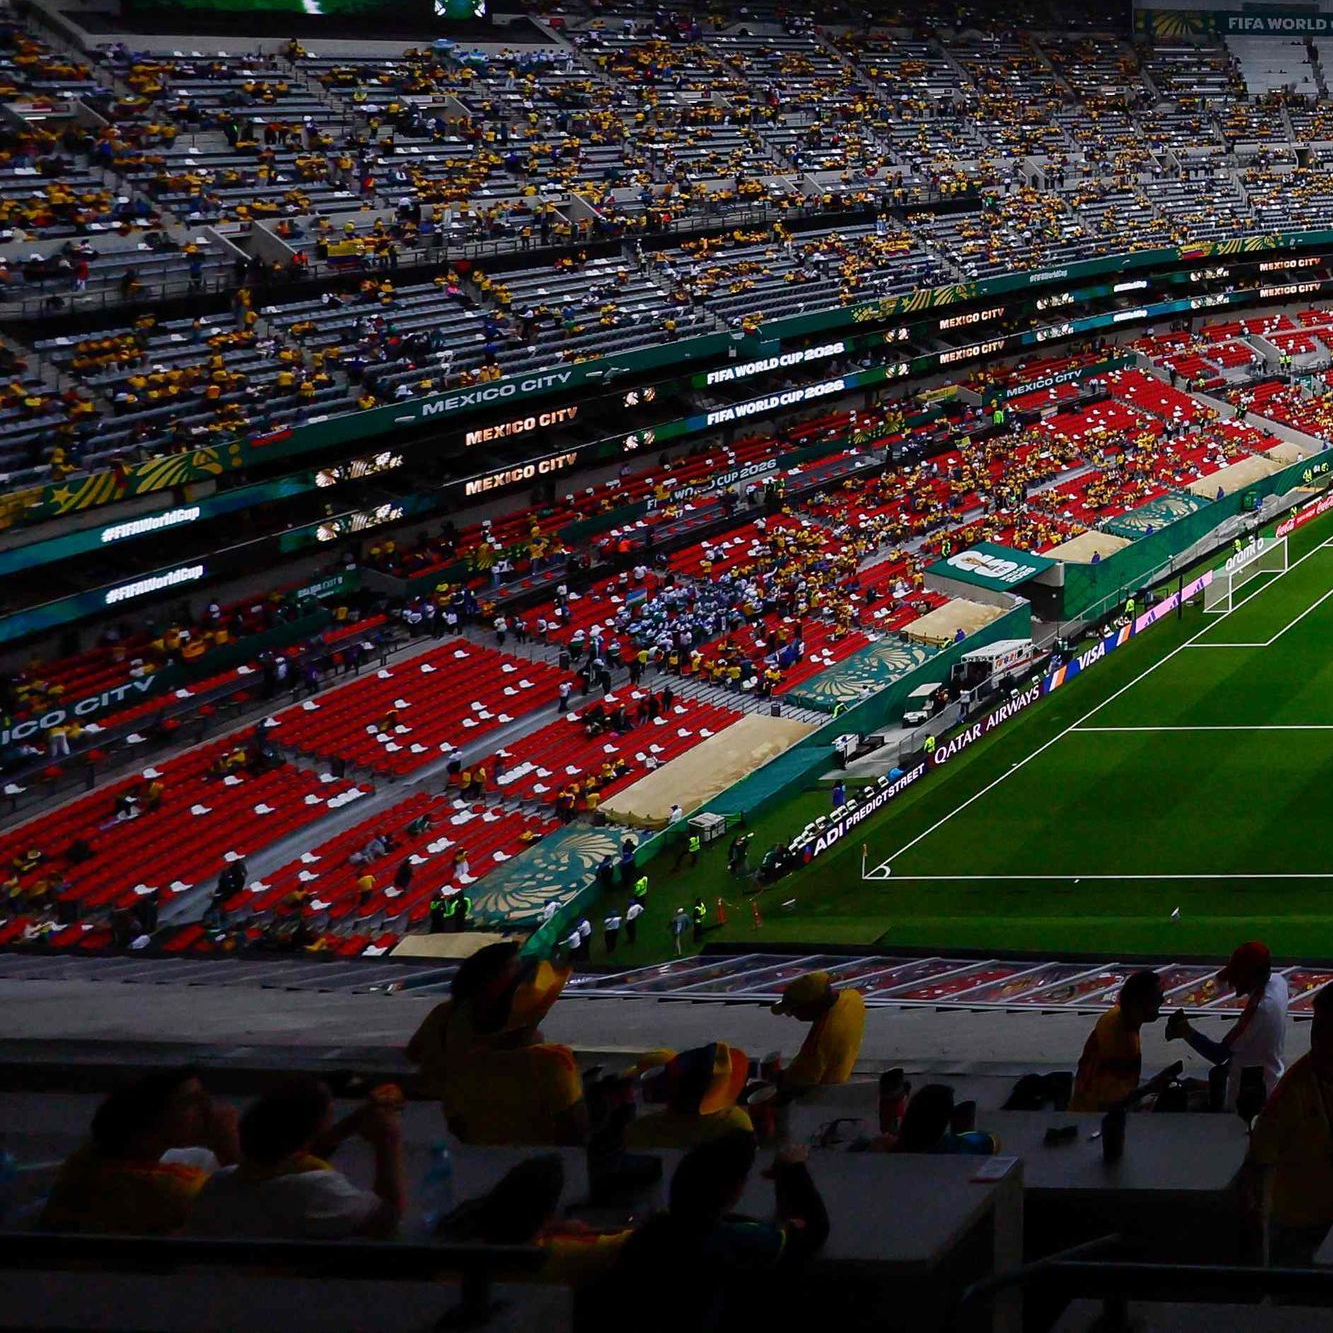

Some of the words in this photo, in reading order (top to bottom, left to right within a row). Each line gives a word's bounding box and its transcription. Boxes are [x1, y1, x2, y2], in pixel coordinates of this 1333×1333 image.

[1228, 17, 1264, 30] FIFA
[1266, 17, 1327, 31] WORLD
[1259, 260, 1297, 271] MEXICO
[1298, 257, 1321, 268] CITY
[1259, 286, 1297, 298] MEXICO
[1298, 283, 1321, 293] CITY
[940, 312, 979, 330] MEXICO
[981, 307, 1005, 321] CITY
[707, 366, 734, 385] FIFA
[735, 358, 780, 381] WORLD
[780, 352, 803, 370] CUP
[803, 342, 845, 365] 2026
[940, 346, 979, 364] MEXICO
[981, 340, 1005, 354] CITY
[421, 384, 516, 417] MEXICO
[520, 370, 572, 394] CITY
[707, 407, 734, 425] FIFA
[735, 398, 780, 421] WORLD
[780, 390, 803, 409] CUP
[803, 379, 845, 404] 2026
[1007, 378, 1053, 398] MEXICO
[1055, 369, 1083, 383] CITY
[466, 417, 535, 446] MEXICO
[539, 406, 578, 429] CITY
[466, 463, 535, 496] MEXICO
[539, 452, 578, 476] CITY
[717, 473, 739, 488] CUP
[739, 458, 777, 478] 2026
[101, 505, 200, 543] #FIFAWorldCup
[105, 565, 204, 604] #FIFAWorldCup
[1077, 642, 1106, 669] VISA
[74, 675, 156, 716] CITY
[934, 724, 981, 765] QATAR
[985, 685, 1040, 732] AIRWAYS
[812, 825, 844, 857] ADI
[845, 764, 925, 830] PREDICTSTREET
